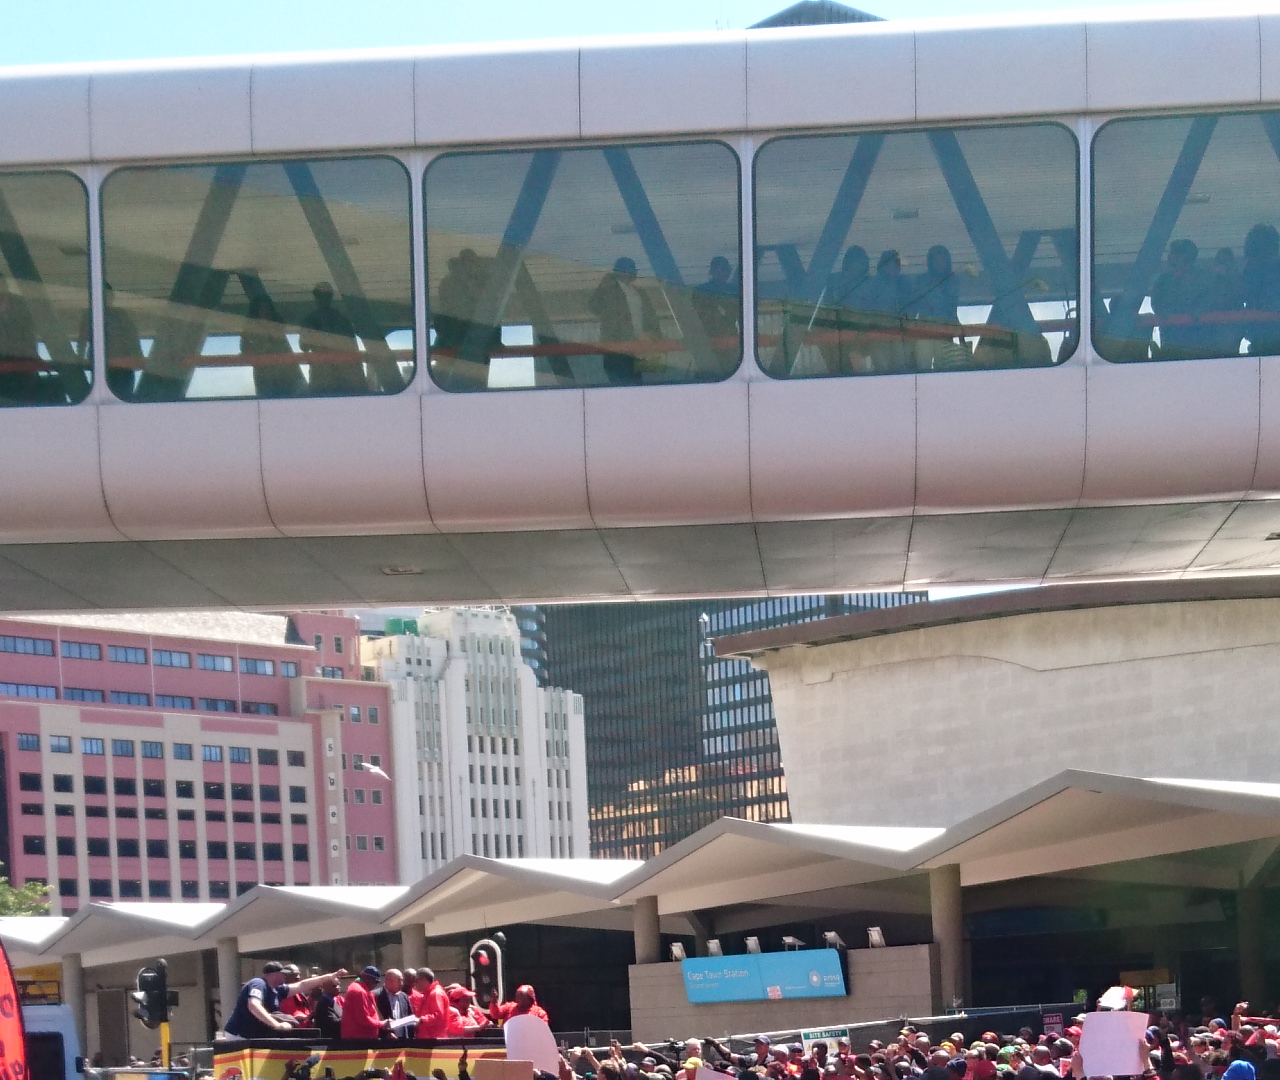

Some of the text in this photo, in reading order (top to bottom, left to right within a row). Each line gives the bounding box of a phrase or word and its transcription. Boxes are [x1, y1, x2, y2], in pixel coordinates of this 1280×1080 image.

[687, 968, 749, 981] Cape Town Station
